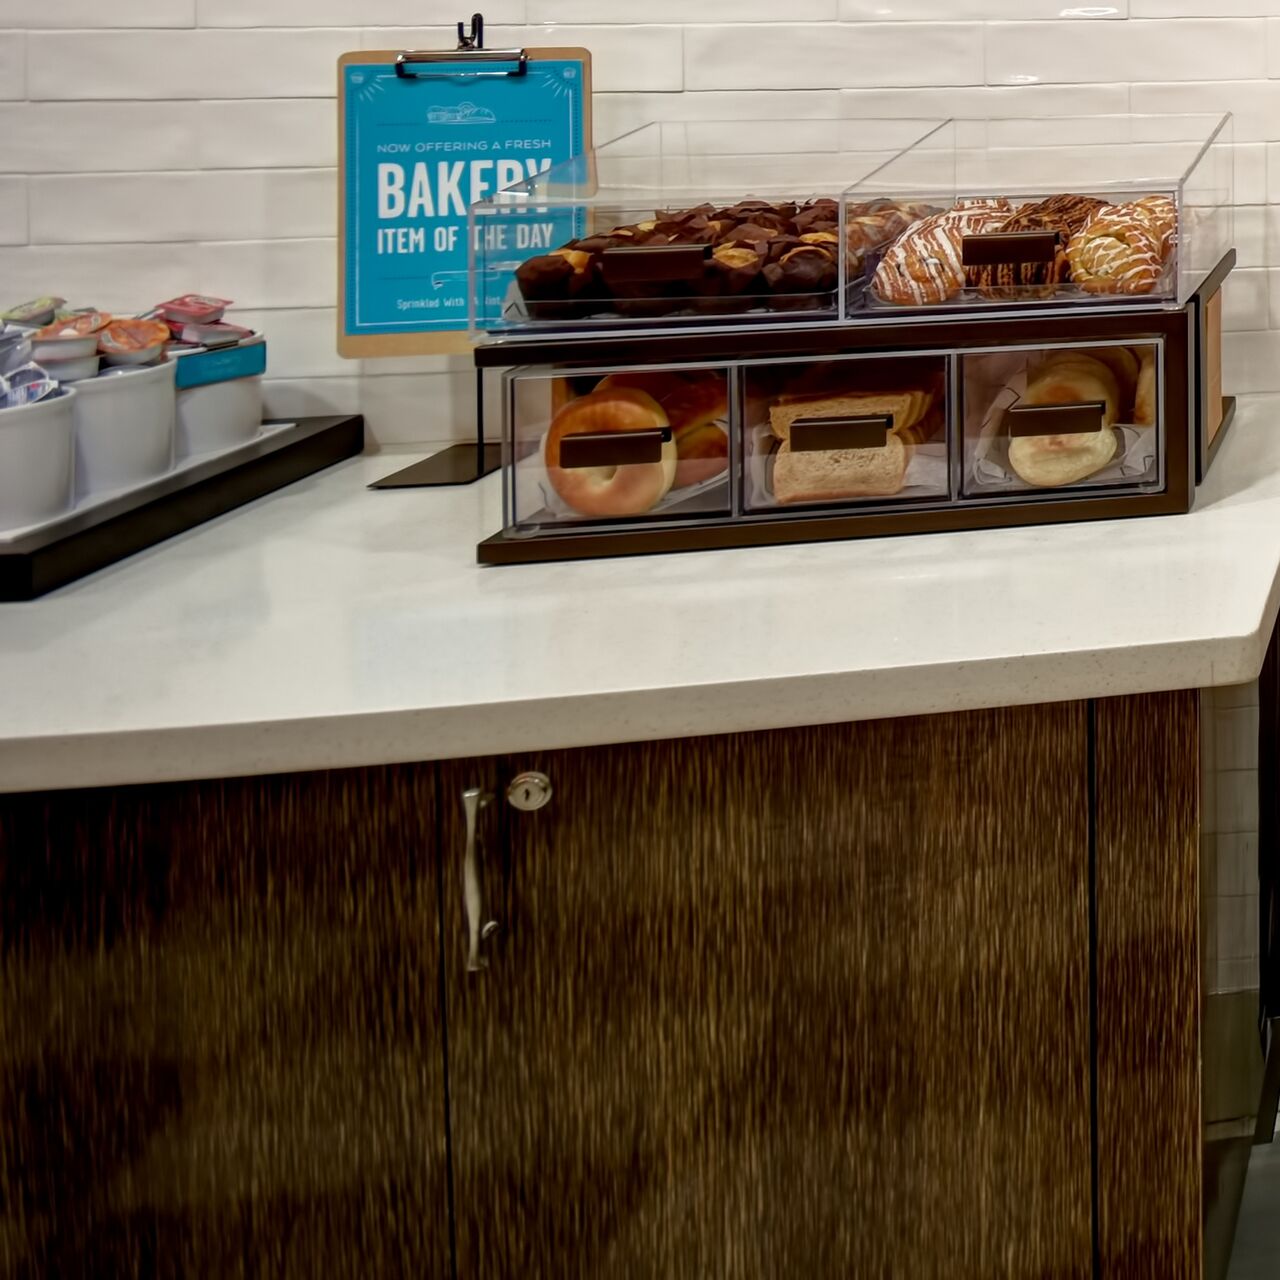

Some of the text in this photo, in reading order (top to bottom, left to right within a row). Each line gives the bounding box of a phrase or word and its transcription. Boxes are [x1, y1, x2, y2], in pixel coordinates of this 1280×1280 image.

[377, 139, 552, 153] NOW OFFERING A FRESH
[377, 158, 552, 219] BAKERY
[377, 223, 554, 254] ITEM OF THE DAY
